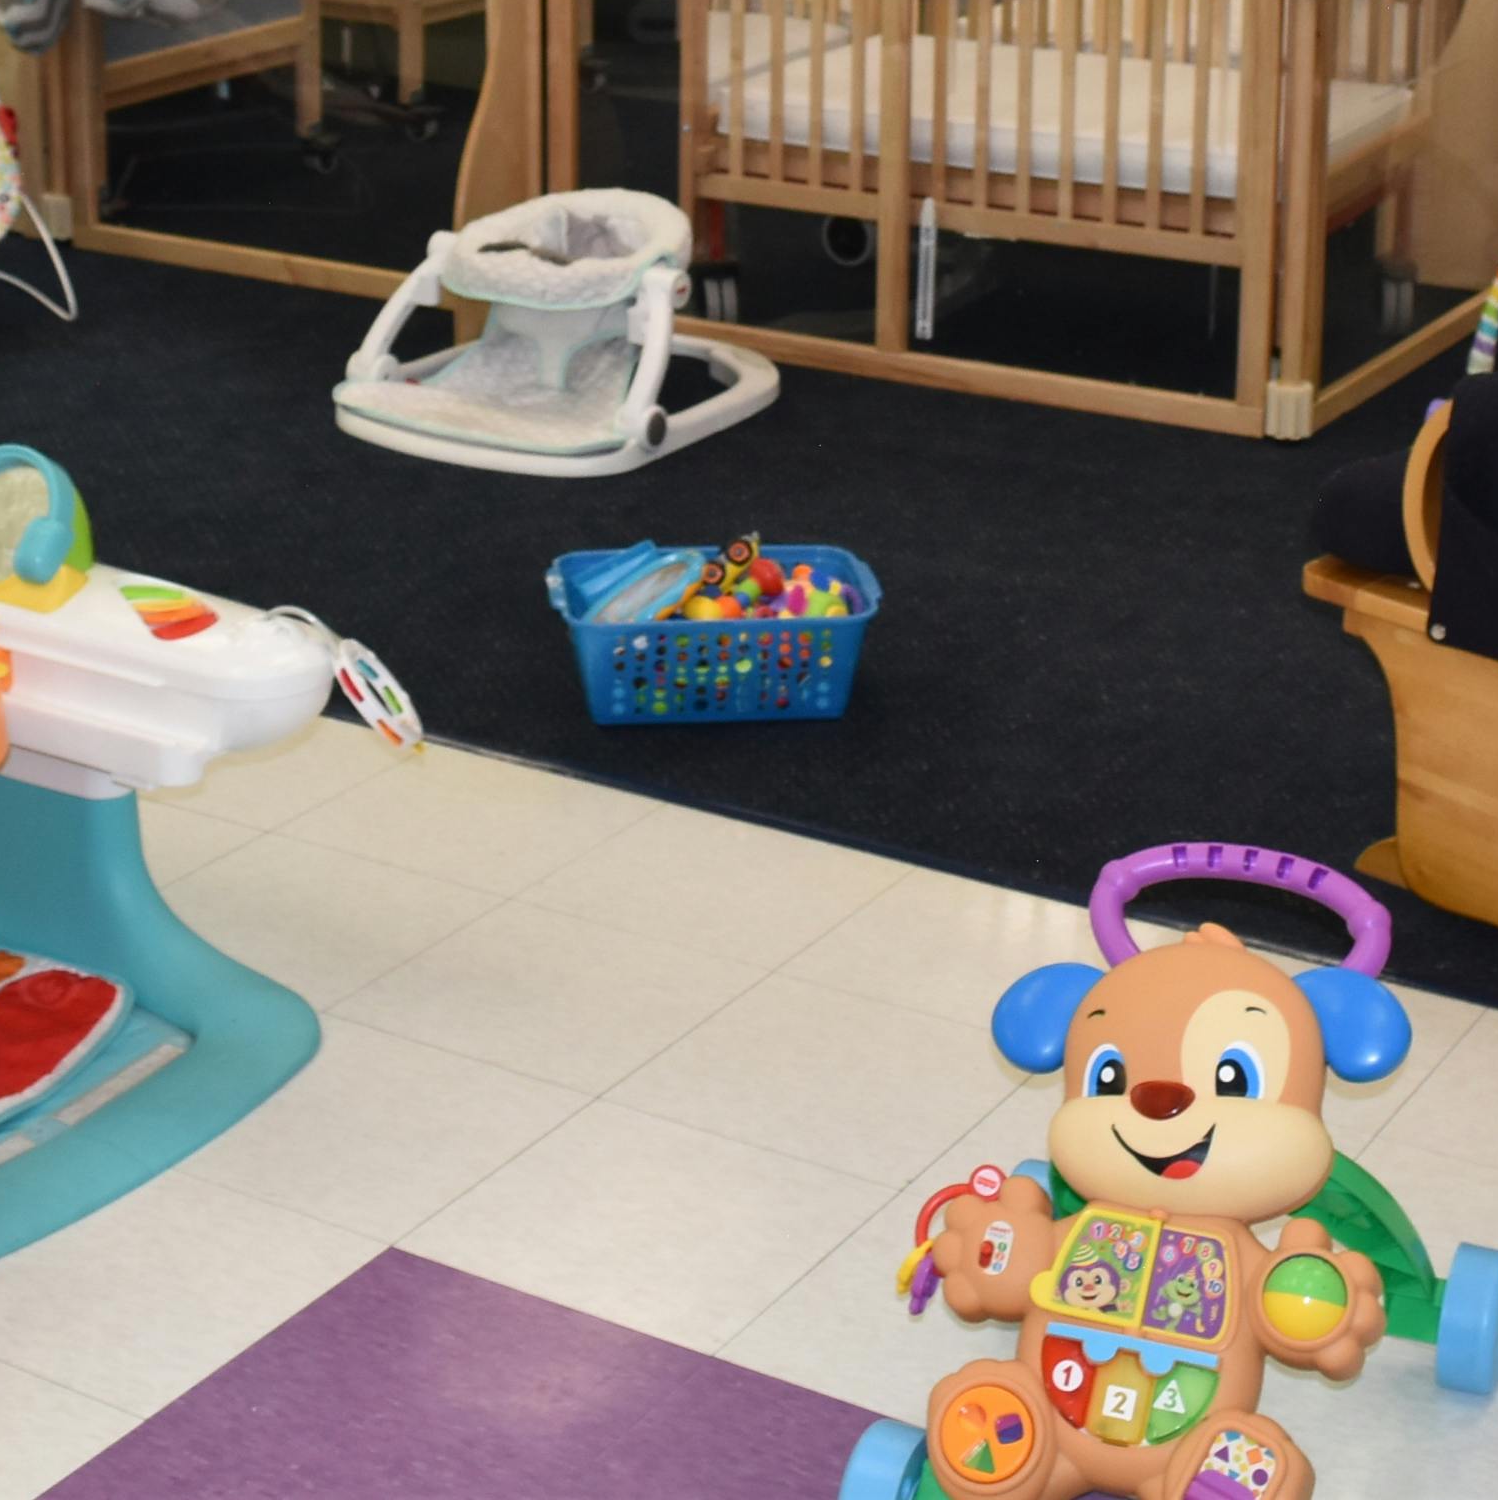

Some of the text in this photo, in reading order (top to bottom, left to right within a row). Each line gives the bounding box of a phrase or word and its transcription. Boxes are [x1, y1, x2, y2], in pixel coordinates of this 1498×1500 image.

[1111, 1225, 1121, 1239] 2
[1134, 1233, 1144, 1248] 3
[1127, 1254, 1140, 1270] 5
[1164, 1238, 1222, 1294] 6 7 8 9 10
[1062, 1365, 1177, 1414] 1 2 3
